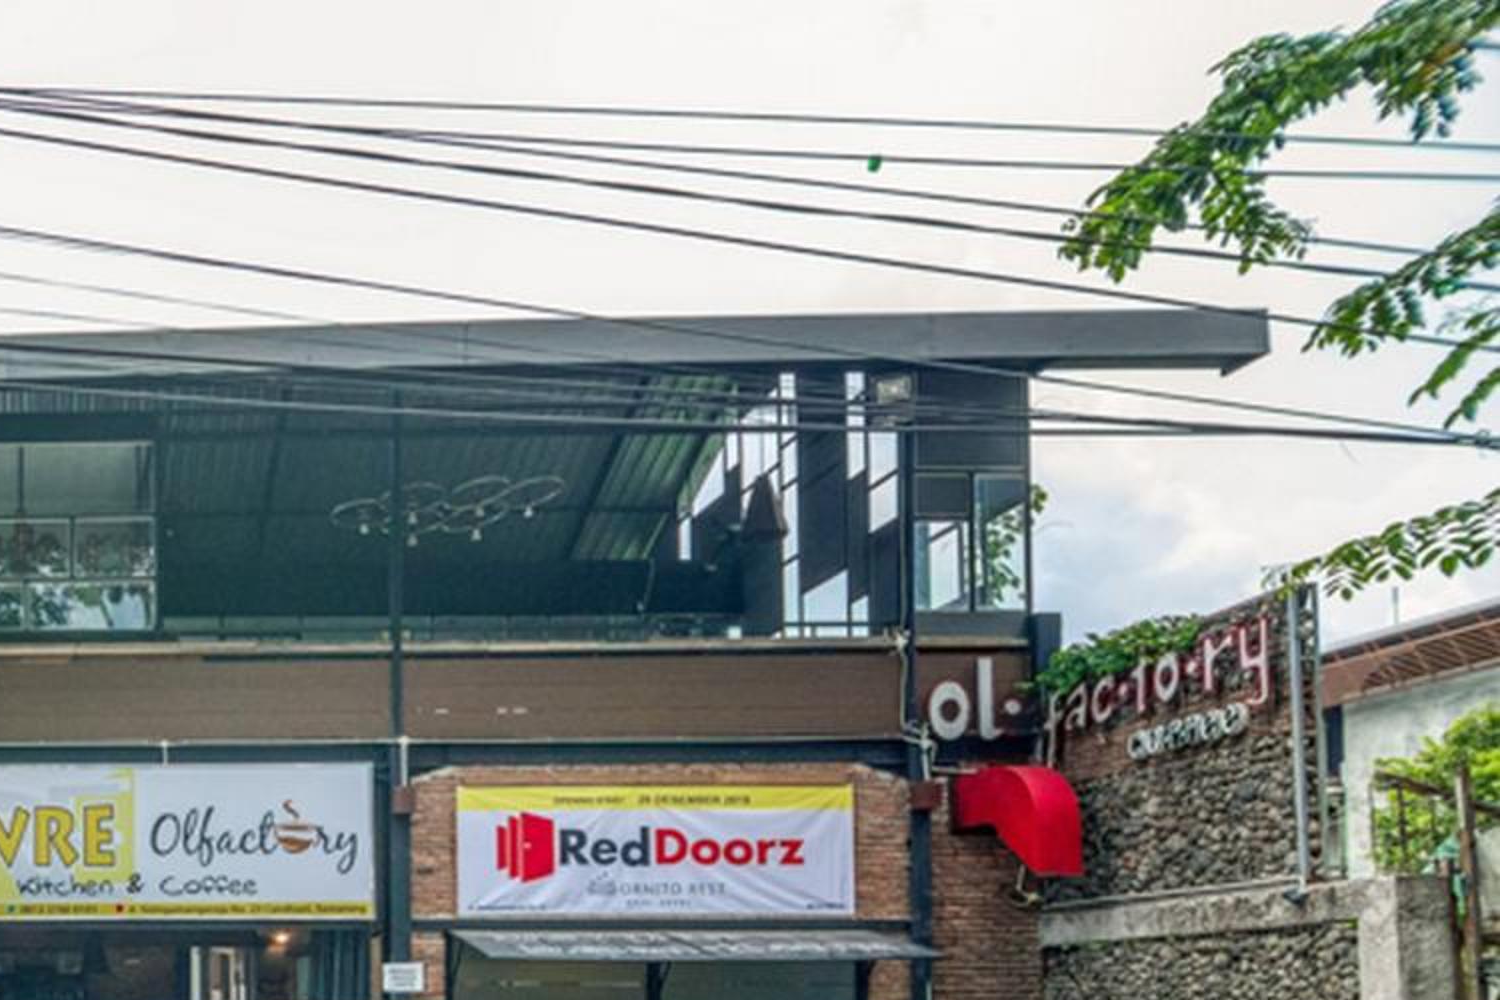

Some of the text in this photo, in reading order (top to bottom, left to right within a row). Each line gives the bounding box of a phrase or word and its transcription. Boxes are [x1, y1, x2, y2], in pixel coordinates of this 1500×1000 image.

[558, 826, 805, 866] RedDoorz
[16, 874, 258, 897] Kitchen & Coffee
